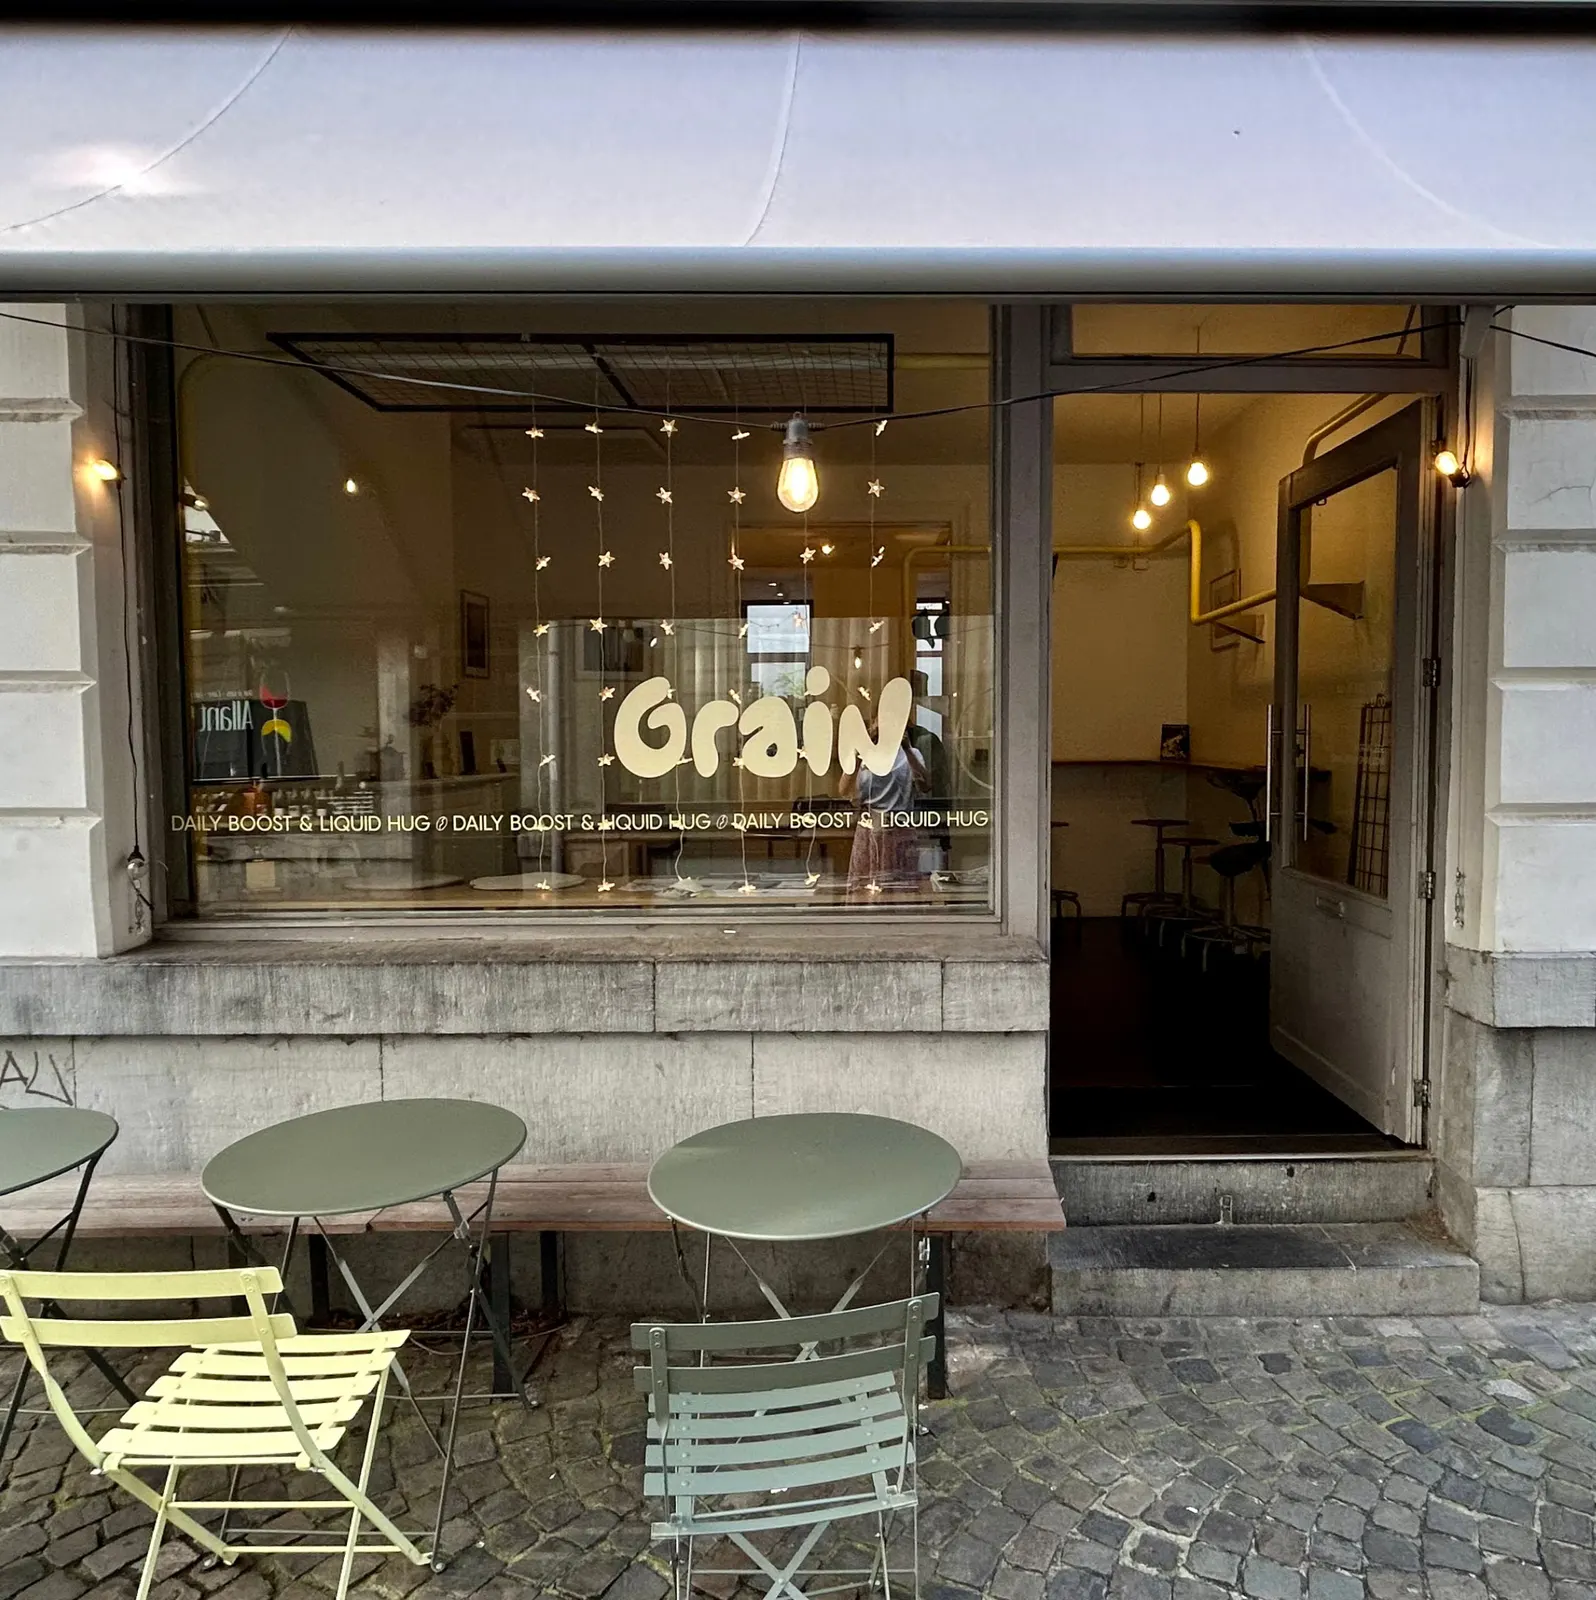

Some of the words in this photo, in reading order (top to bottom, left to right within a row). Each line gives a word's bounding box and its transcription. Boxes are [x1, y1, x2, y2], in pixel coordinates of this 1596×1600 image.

[171, 814, 222, 832] DAILY
[228, 814, 293, 832] BOOST
[299, 814, 313, 832] &
[319, 814, 382, 832] LIQUID
[387, 814, 431, 832] HUG
[452, 814, 504, 832] DAILY
[510, 814, 575, 831] BOOST
[581, 813, 595, 831] &
[668, 813, 711, 830] HUG
[733, 812, 784, 830] DAILY
[790, 811, 854, 829] BOOST
[860, 811, 873, 829] &
[880, 810, 941, 828] LIQUID
[946, 810, 989, 827] HUG
